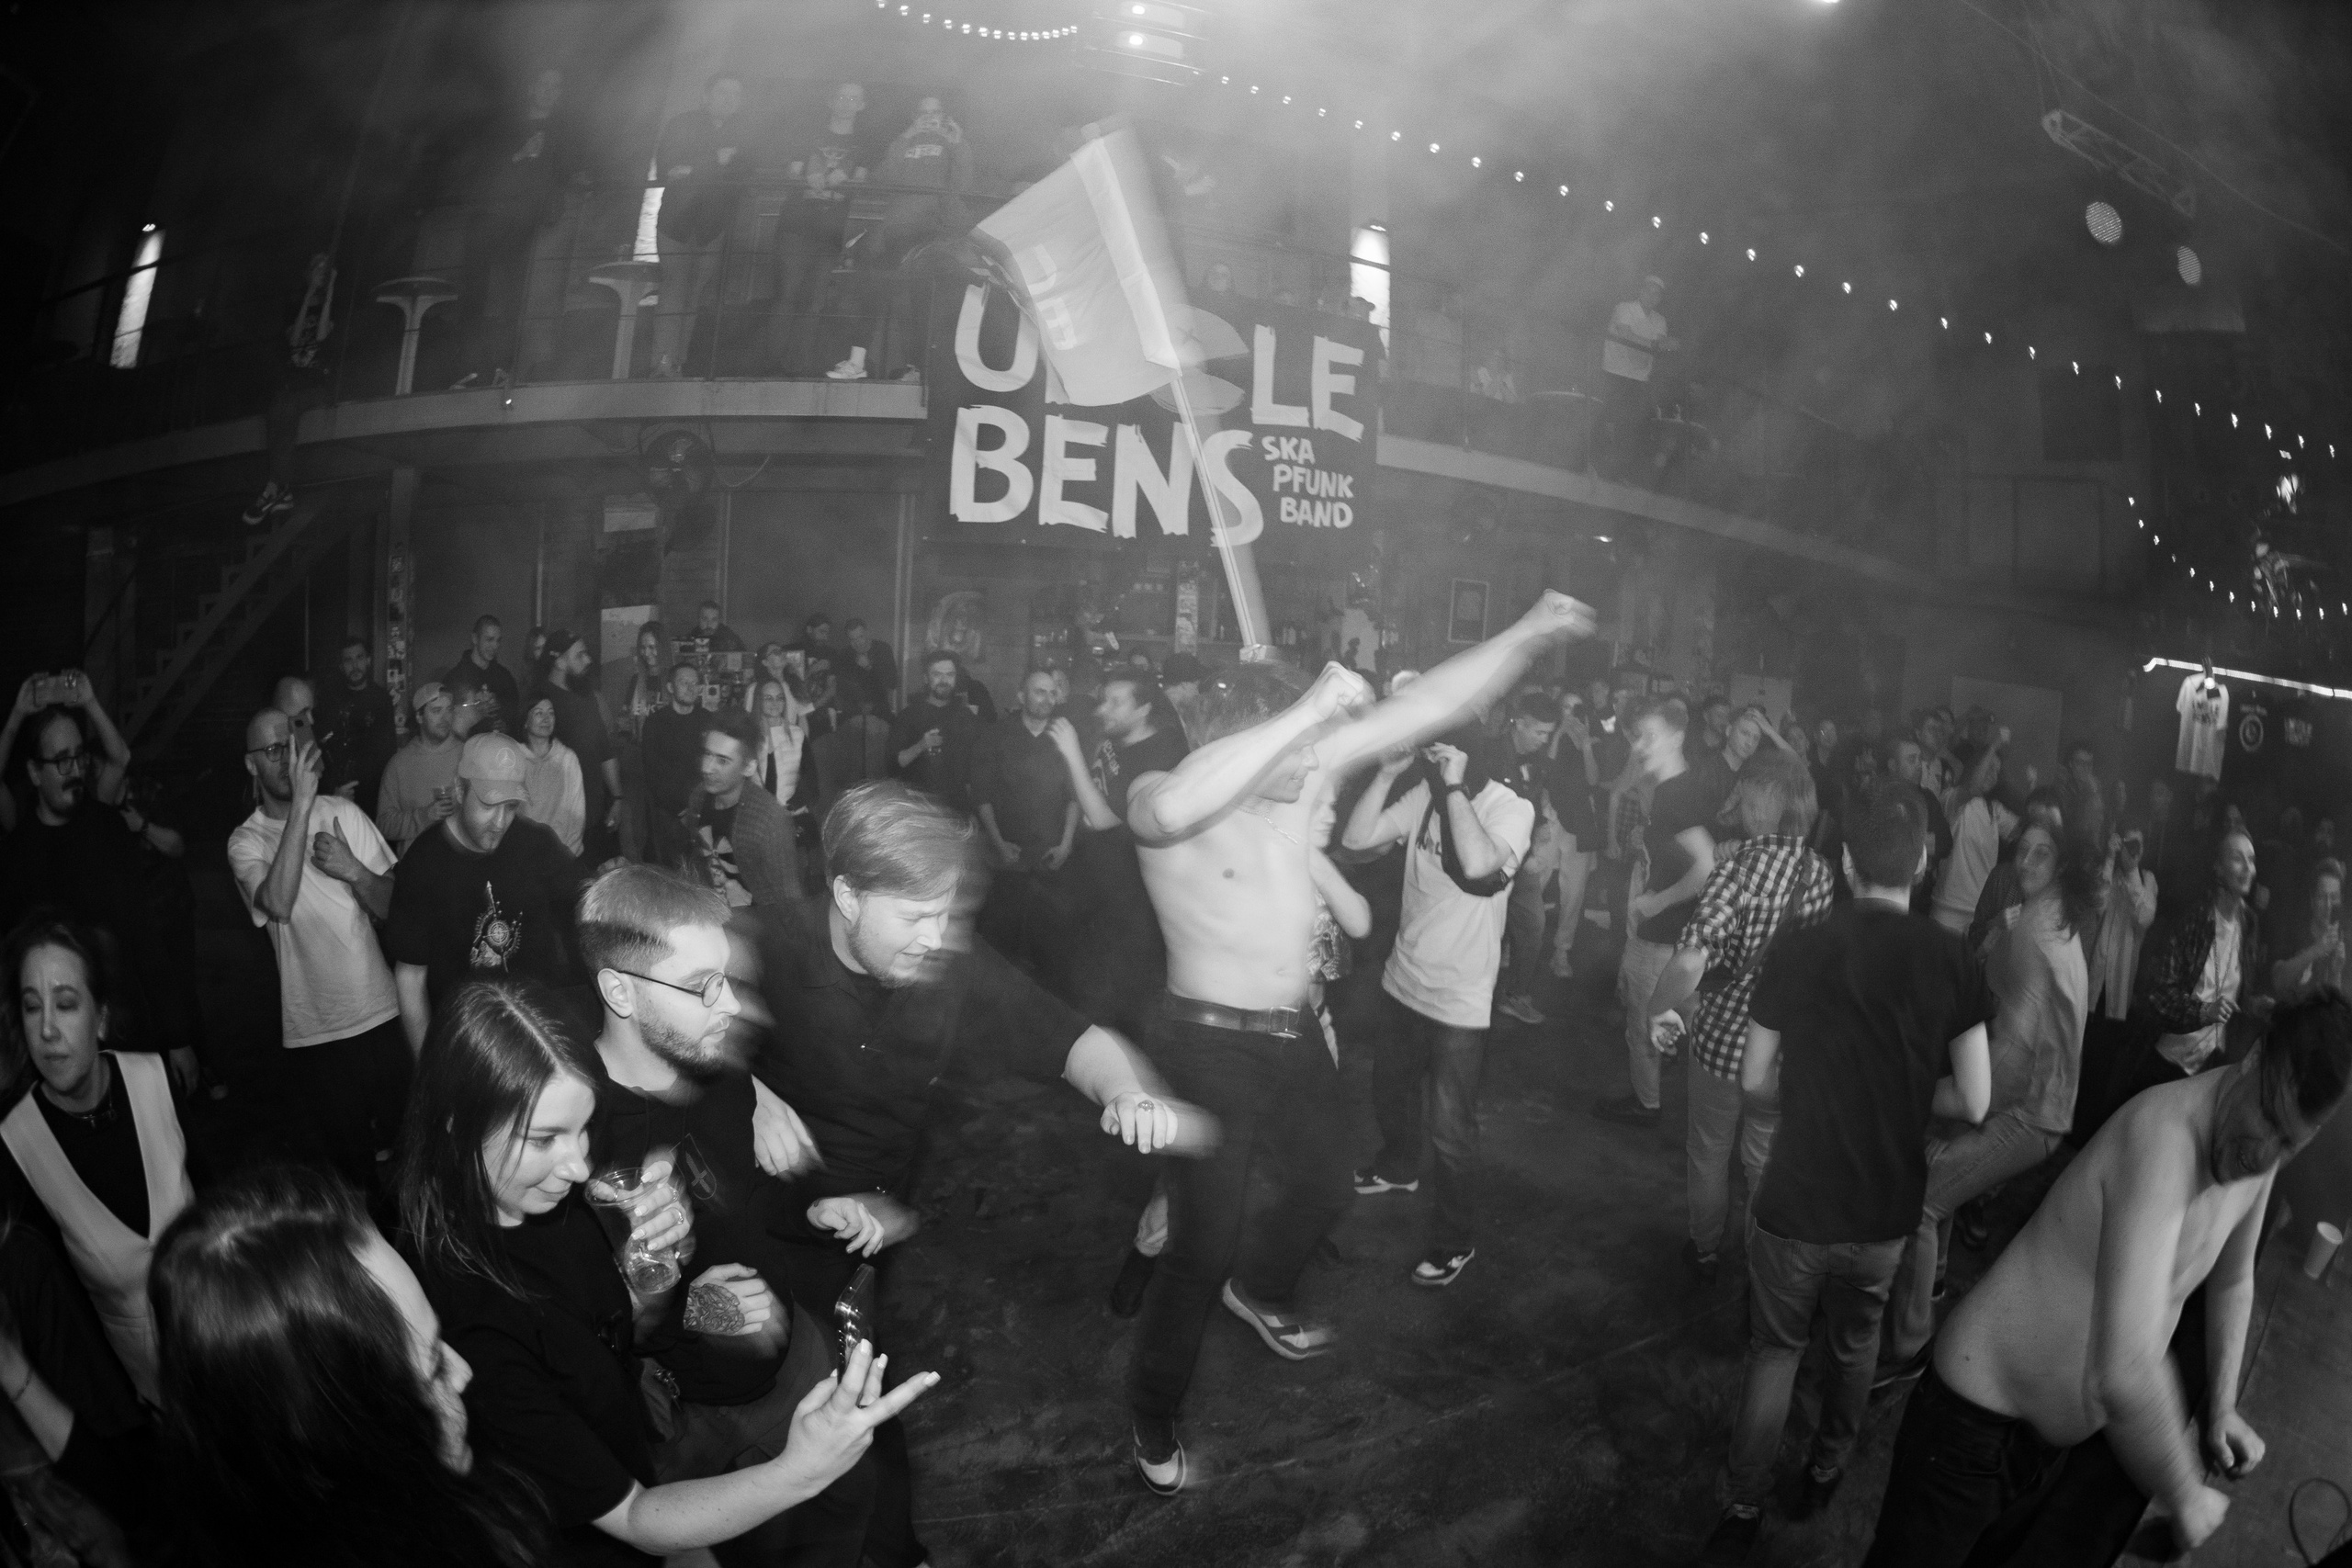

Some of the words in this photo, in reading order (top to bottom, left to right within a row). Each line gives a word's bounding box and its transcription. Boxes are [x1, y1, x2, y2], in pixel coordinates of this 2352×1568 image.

[955, 282, 1365, 444] ULE
[1261, 435, 1316, 465] SKA
[949, 404, 1264, 547] BENS
[1272, 463, 1354, 499] PFUNK
[1280, 496, 1354, 529] BAND
